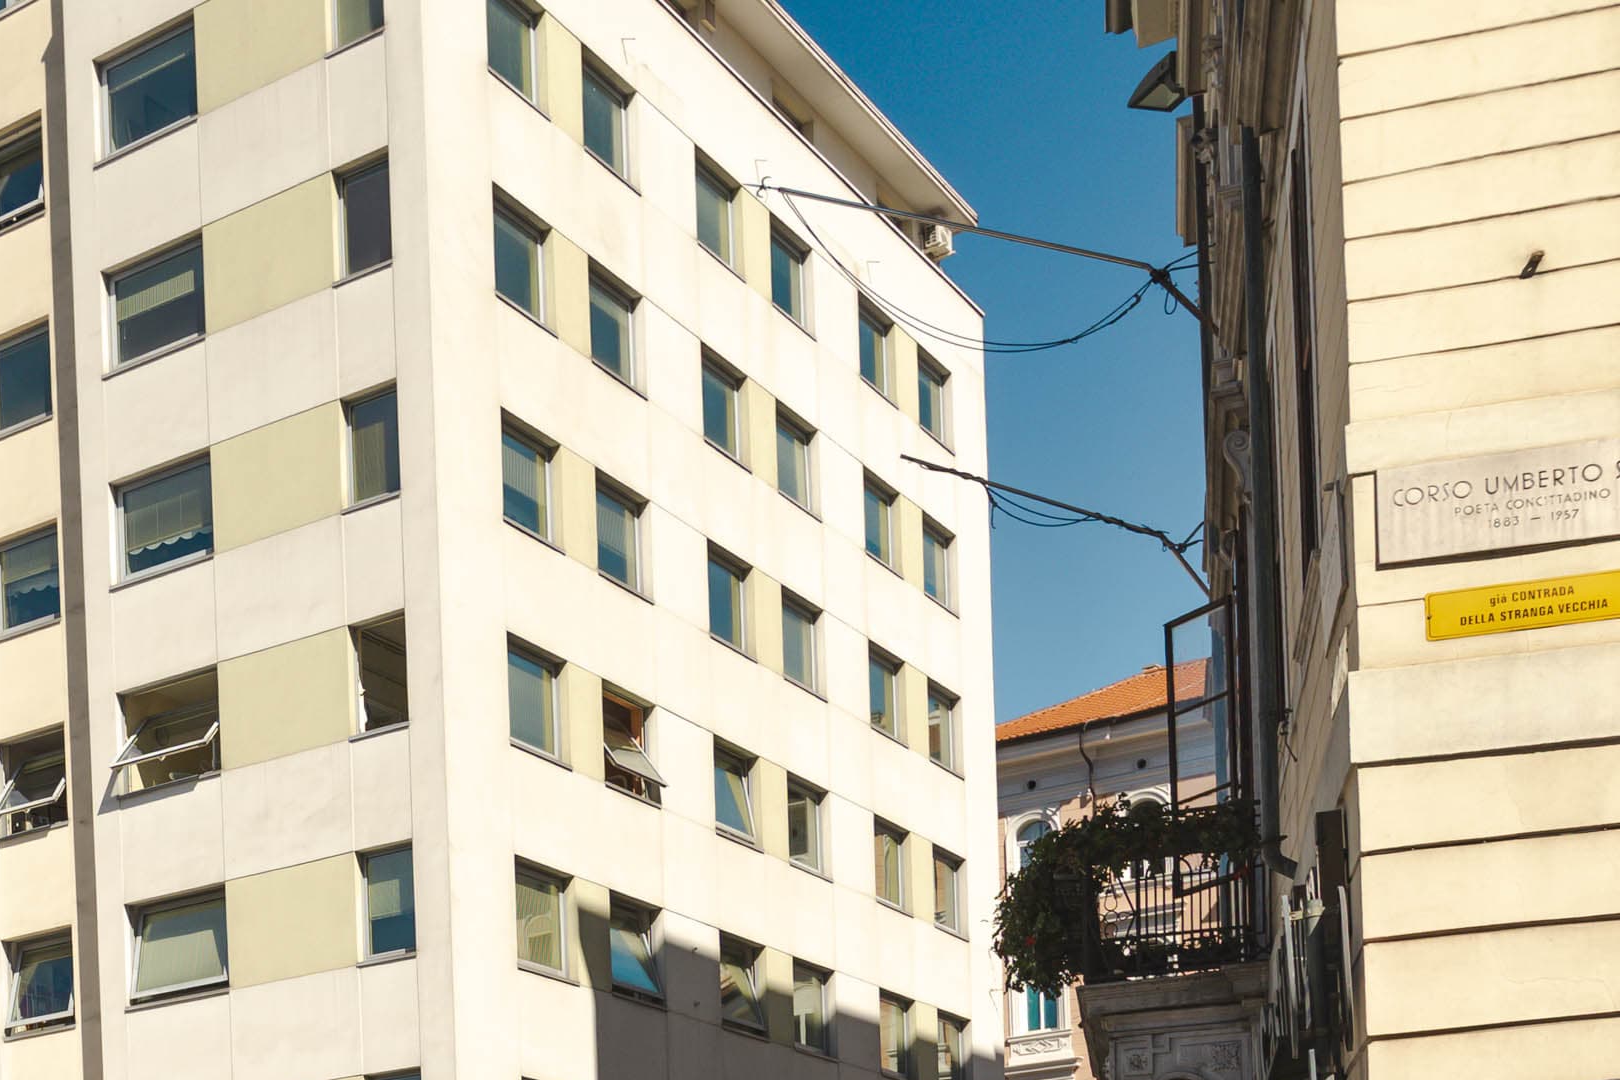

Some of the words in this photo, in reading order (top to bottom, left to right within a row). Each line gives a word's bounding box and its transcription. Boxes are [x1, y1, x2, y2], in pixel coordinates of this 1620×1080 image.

[1393, 480, 1473, 507] CORSO
[1485, 463, 1603, 495] UMBERTO
[1454, 503, 1499, 517] POETA
[1506, 488, 1611, 510] CONCITTADINO
[1487, 515, 1520, 529] 1883
[1551, 508, 1579, 521] 1957
[1511, 585, 1575, 602] CONTRADA
[1460, 612, 1495, 626] DELLA
[1500, 604, 1554, 621] STRANGA
[1558, 598, 1608, 614] VECCHIA
